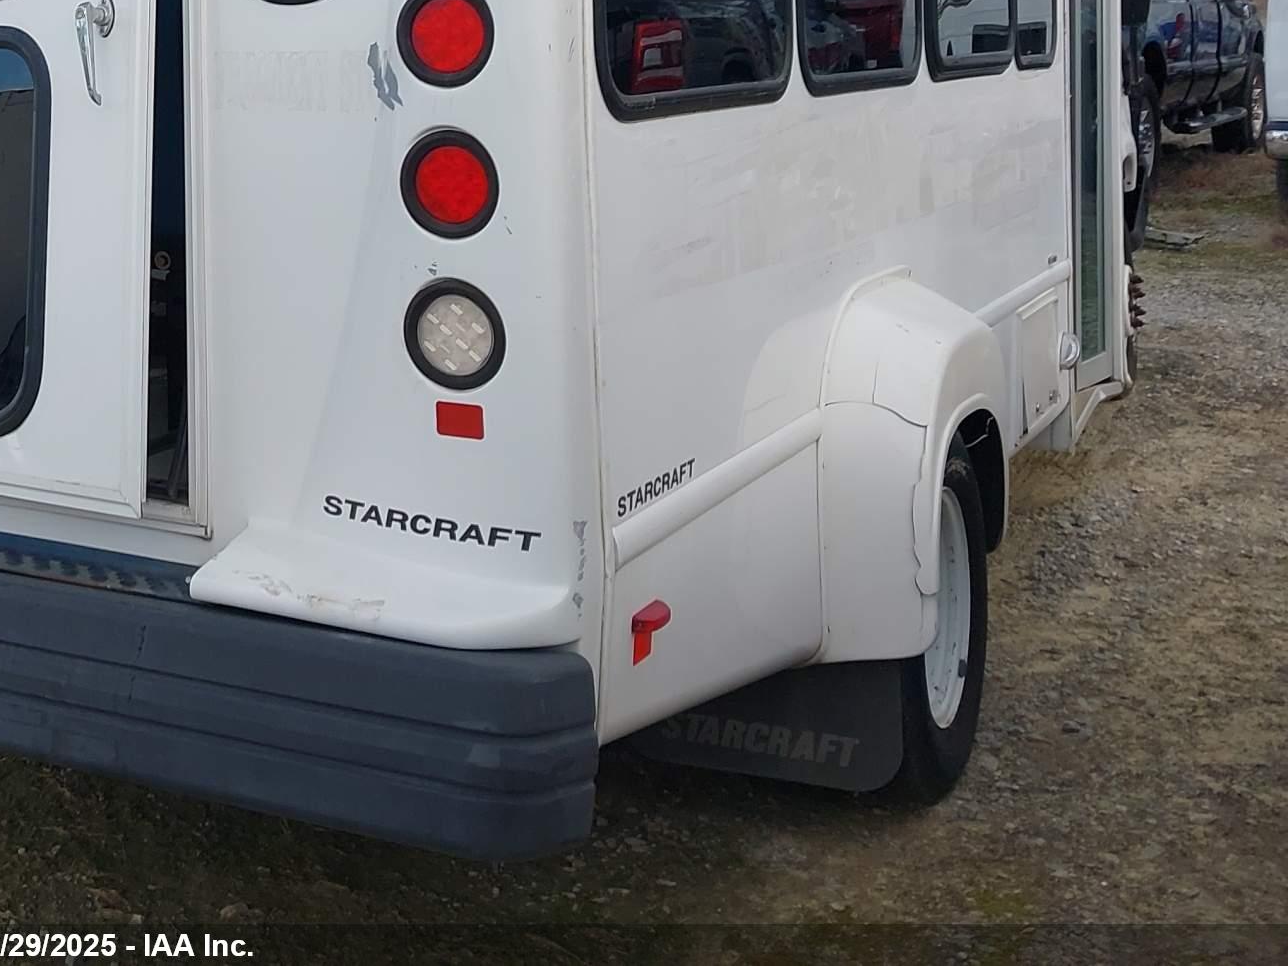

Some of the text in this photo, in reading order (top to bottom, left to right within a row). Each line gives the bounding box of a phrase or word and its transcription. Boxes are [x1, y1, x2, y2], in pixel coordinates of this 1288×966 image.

[617, 457, 696, 518] STARCRAFT
[323, 495, 542, 552] STARCRAFT
[661, 712, 861, 768] STARCRAFT
